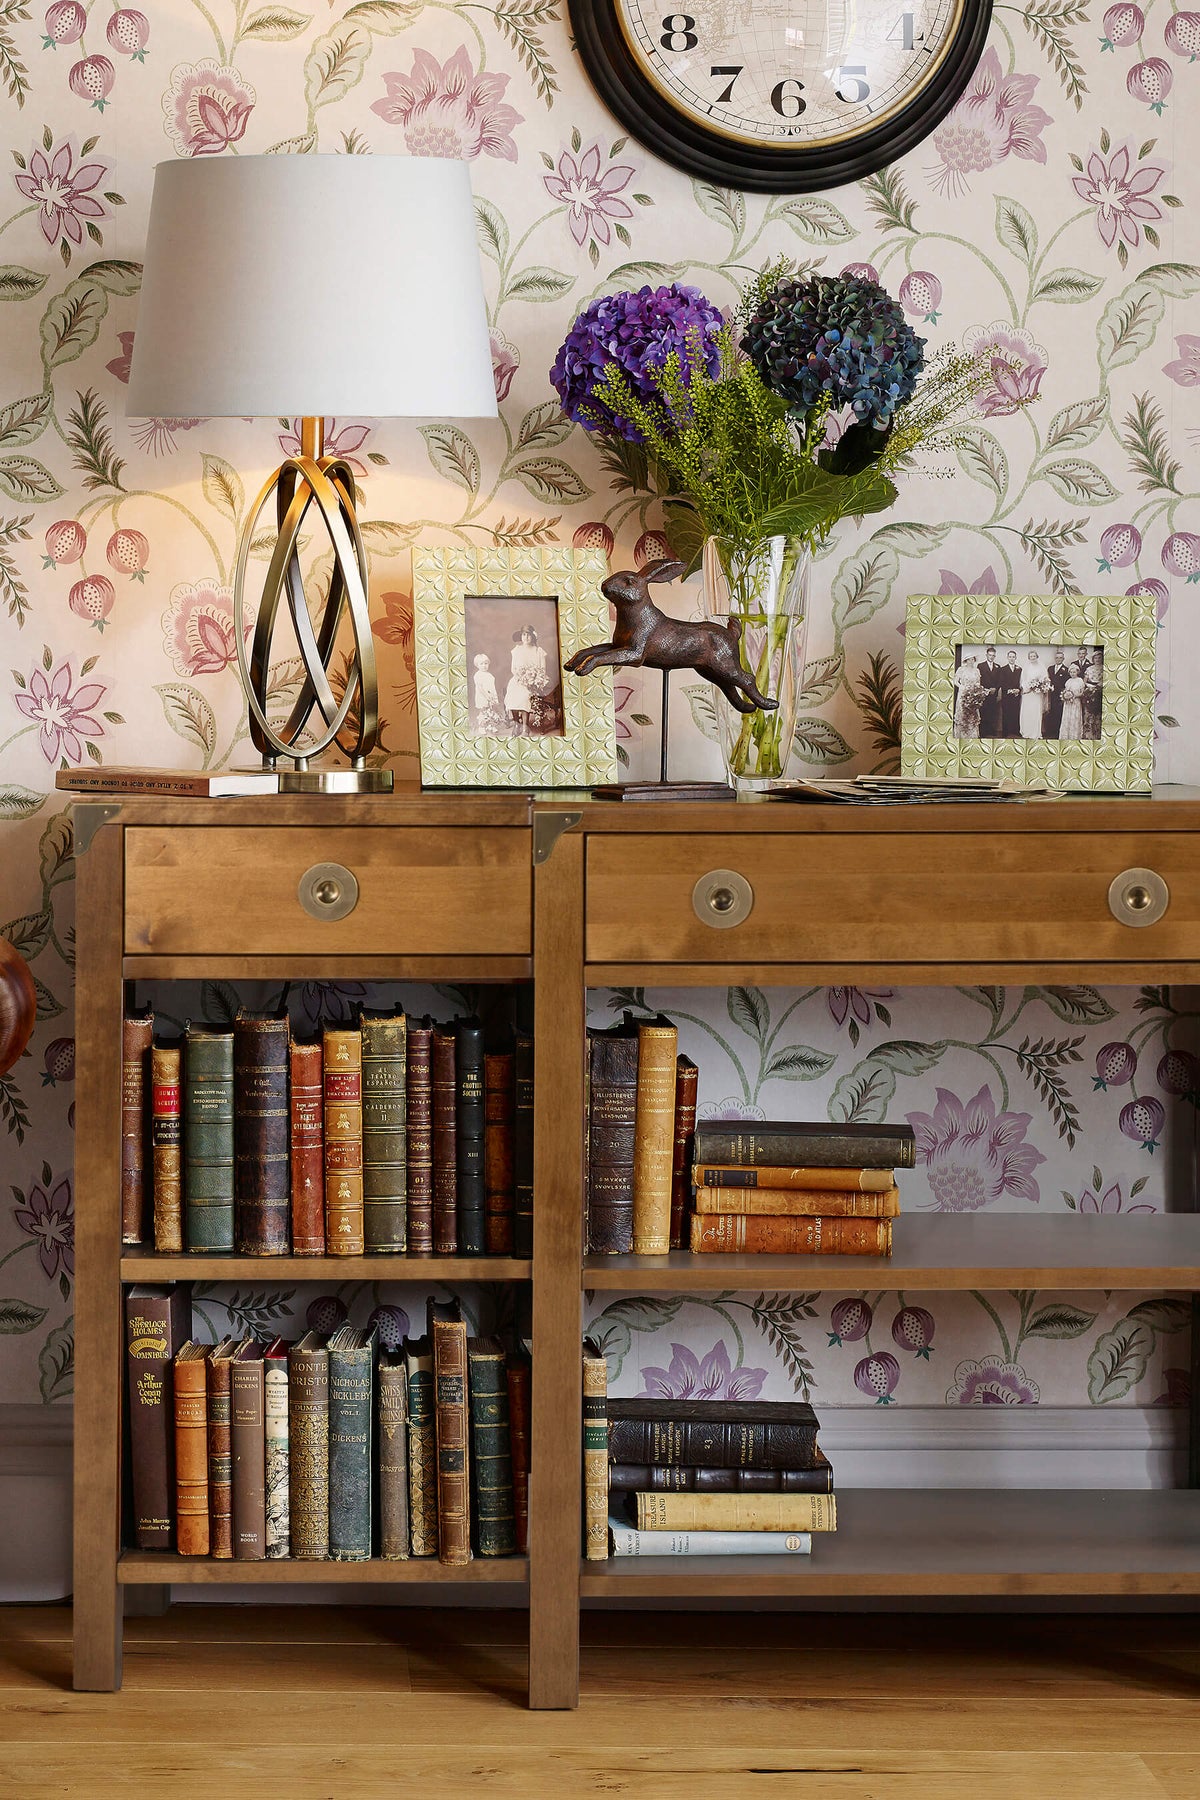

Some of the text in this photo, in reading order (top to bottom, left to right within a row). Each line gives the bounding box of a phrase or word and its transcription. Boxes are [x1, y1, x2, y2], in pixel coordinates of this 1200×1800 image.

[660, 14, 698, 52] 8
[886, 12, 924, 51] 4
[710, 65, 744, 103] 7
[835, 65, 870, 103] 5
[771, 79, 807, 118] 6
[129, 1319, 167, 1329] SHERLOCK
[133, 1327, 163, 1337] HOLMES
[136, 1351, 169, 1359] OMNIBUS
[291, 1362, 328, 1372] MONTE
[143, 1372, 155, 1381] Sir
[291, 1376, 328, 1386] CRISTO
[330, 1376, 370, 1387] NICHOLAS
[137, 1380, 163, 1389] Arthur
[139, 1388, 161, 1397] Conan
[330, 1390, 371, 1401] NICKLEBY
[380, 1384, 401, 1397] SWISS
[140, 1396, 161, 1406] Doyle
[380, 1396, 404, 1409] AMILY
[332, 1433, 367, 1443] DICKENS
[659, 1498, 667, 1525] ISLAND
